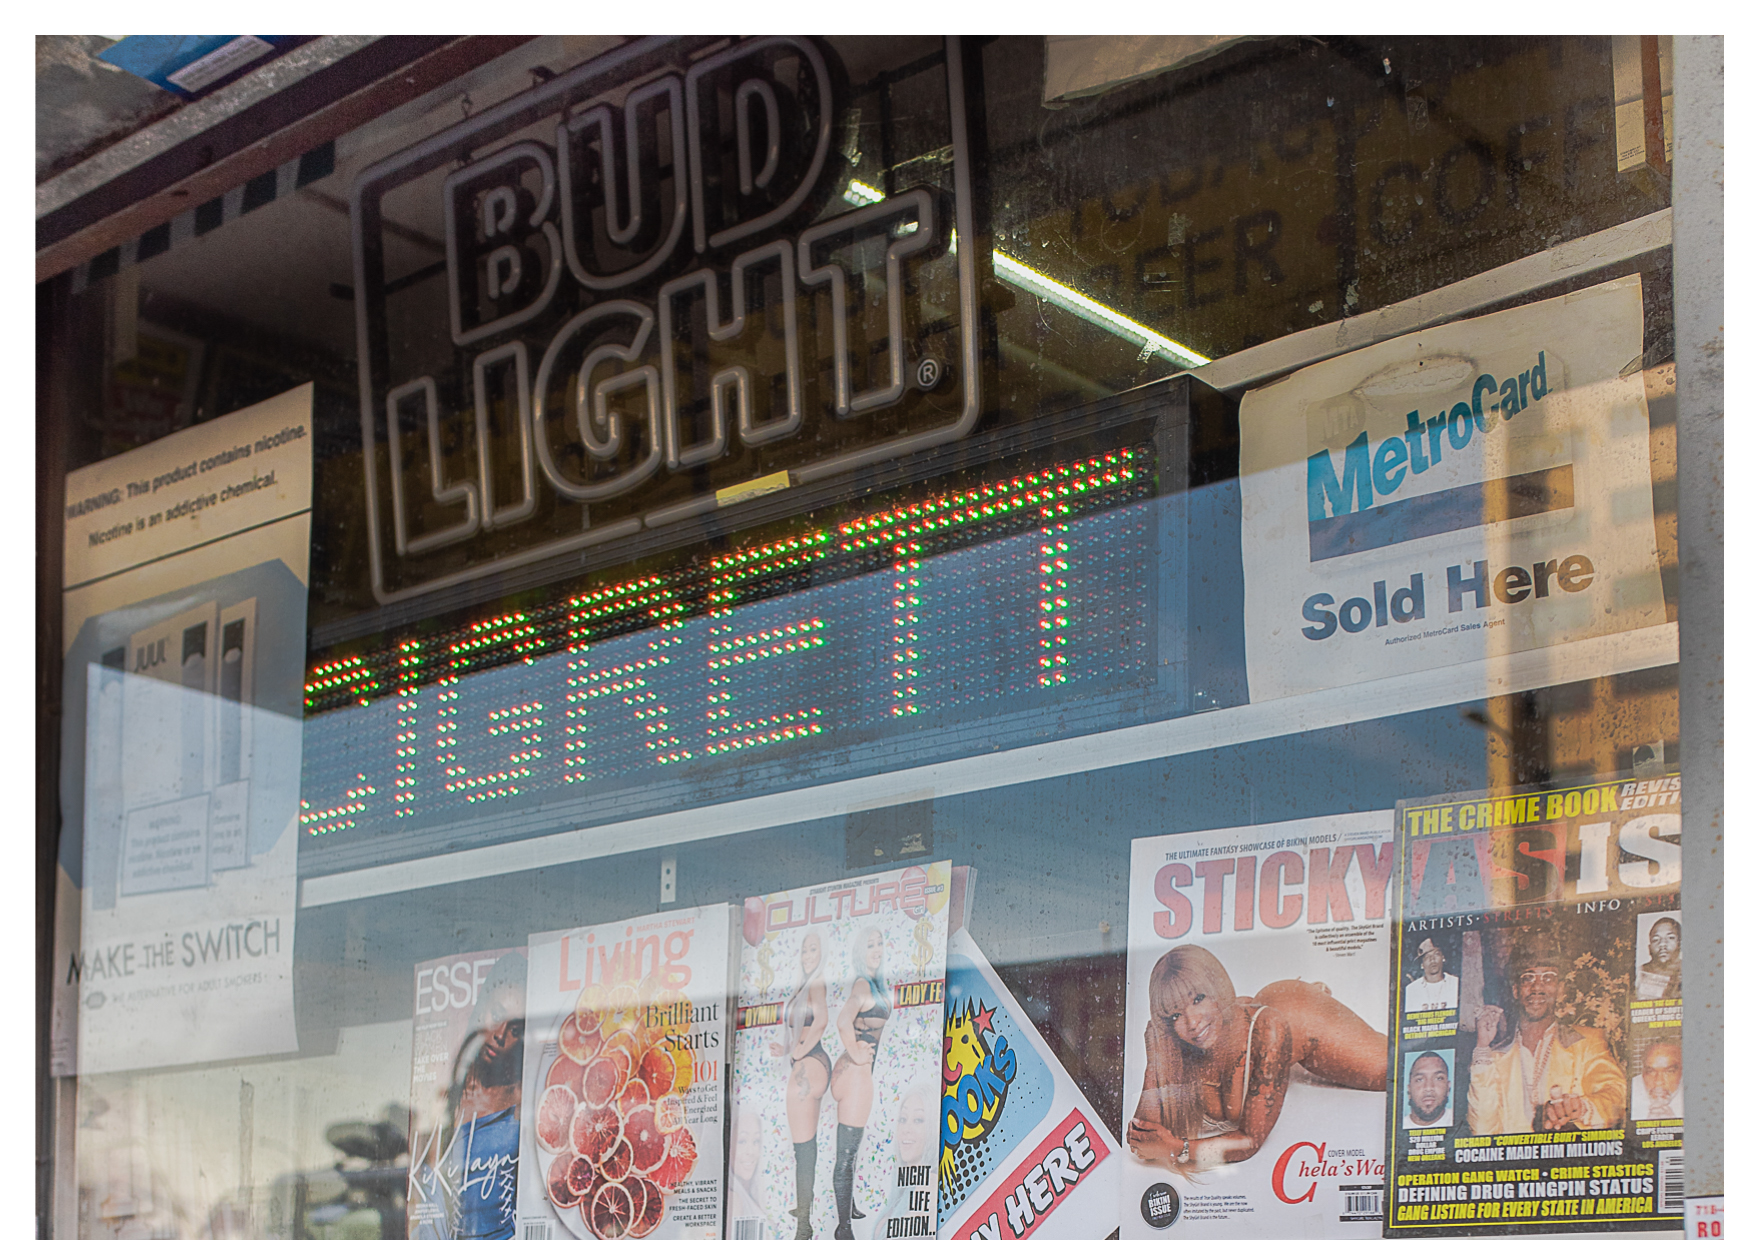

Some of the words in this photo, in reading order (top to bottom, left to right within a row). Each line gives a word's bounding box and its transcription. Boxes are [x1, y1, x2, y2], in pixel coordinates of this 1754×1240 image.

[446, 34, 833, 345] BUD
[387, 187, 933, 556] LIGHT
[1306, 351, 1548, 522] MetroCard
[1300, 574, 1425, 641] Sold
[1446, 554, 1595, 615] Here
[1384, 632, 1421, 646] Authorized
[1422, 627, 1459, 640] MetroCard
[1460, 623, 1480, 633] Sales
[1483, 618, 1505, 630] Agent
[1153, 841, 1395, 940] STICKY
[558, 924, 695, 992] Living
[645, 1002, 720, 1028] Brilliant
[664, 1028, 720, 1052] Starts
[898, 1165, 931, 1188] NIGHT
[909, 1191, 930, 1213] LIFE
[1007, 1121, 1097, 1238] HERE
[1399, 1183, 1467, 1202] DEFINING
[1470, 1181, 1514, 1200] DRUG
[1518, 1180, 1586, 1199] KINGPIN
[1589, 1178, 1654, 1196] STATUS
